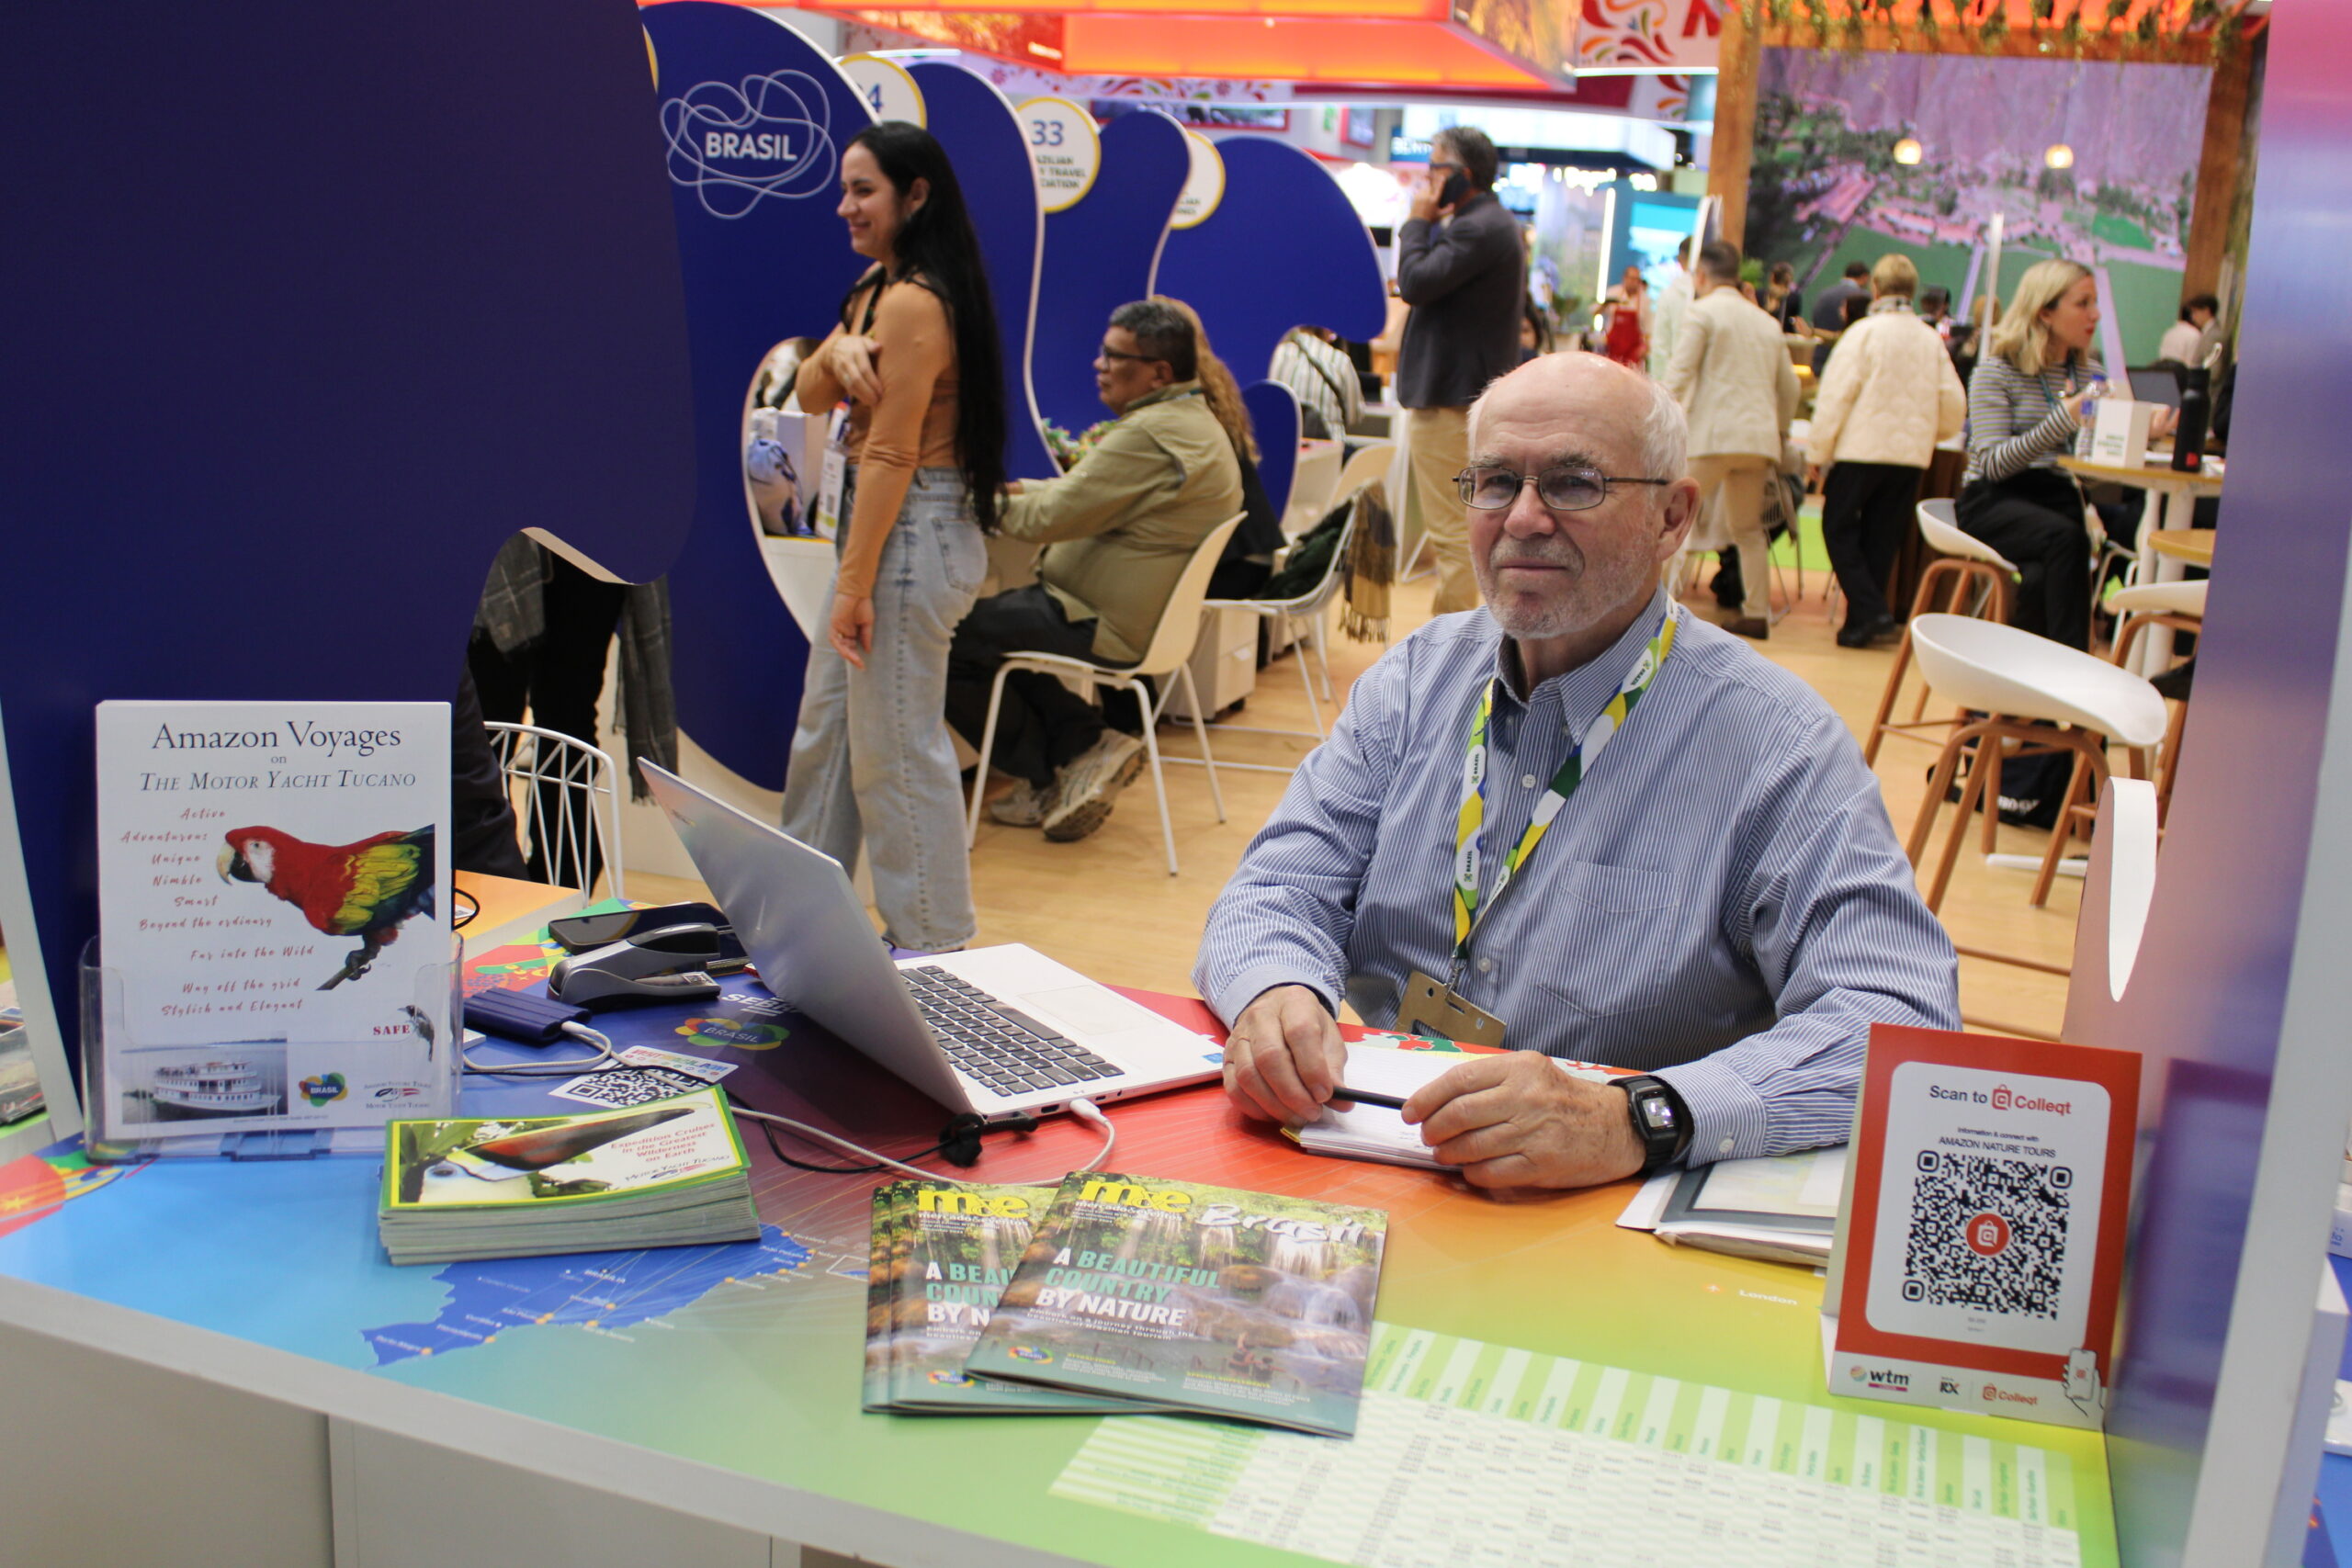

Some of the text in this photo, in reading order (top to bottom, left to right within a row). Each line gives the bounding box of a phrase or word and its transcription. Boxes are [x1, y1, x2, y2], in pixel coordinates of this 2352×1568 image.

[1030, 119, 1065, 146] 33
[705, 131, 797, 162] BRASIL
[1036, 155, 1074, 165] AZILIAN
[1050, 167, 1086, 178] TRAVEL
[1040, 178, 1080, 188] CIATION
[152, 720, 401, 758] Amazon Voyages
[270, 754, 287, 764] on
[140, 769, 416, 791] THE MOTOR YACHT TUCANO
[180, 807, 226, 819] Active
[152, 853, 201, 866] Unique
[153, 874, 202, 887] Nimble
[174, 894, 219, 908] Smart
[139, 915, 272, 932] Beyond the ordinary
[190, 944, 315, 962] Far into the Wild
[182, 976, 300, 995] Way off the grid
[162, 998, 304, 1018] Stylish and Elegant
[372, 1024, 411, 1036] SAFE
[703, 1025, 758, 1043] BRASIL
[310, 1086, 339, 1094] BRASIL
[1929, 1085, 2072, 1117] Scan to Colleqt
[610, 1122, 716, 1150] Expedition Cruises
[637, 1142, 655, 1151] the
[658, 1131, 707, 1145] Greatest
[1957, 1126, 1992, 1138] Information
[1999, 1132, 2025, 1142] connect
[2026, 1134, 2040, 1143] with
[636, 1140, 697, 1157] Wilderness
[645, 1147, 695, 1163] on Earth
[1939, 1136, 2056, 1158] AMAZON NATURE TOURS
[919, 1190, 1030, 1219] m&e
[1078, 1180, 1193, 1213] m&e
[1194, 1203, 1368, 1245] Brasil
[926, 1261, 943, 1280] A
[1053, 1247, 1221, 1290] A BEAUTIFUL
[926, 1282, 1000, 1307] COUN
[1044, 1268, 1173, 1304] COUNTRY
[1738, 1289, 1798, 1305] London
[927, 1303, 963, 1324] BY
[1035, 1288, 1188, 1326] BY NATURE
[926, 1325, 965, 1334] Embark
[1027, 1312, 1070, 1325] beauties
[1085, 1322, 1130, 1336] Brazilian
[1029, 1307, 1068, 1320] Embark
[1092, 1317, 1133, 1331] journey
[1135, 1323, 1176, 1337] through
[926, 1332, 971, 1341] beauties
[1870, 1369, 2039, 1405] wtm RX Colleqt
